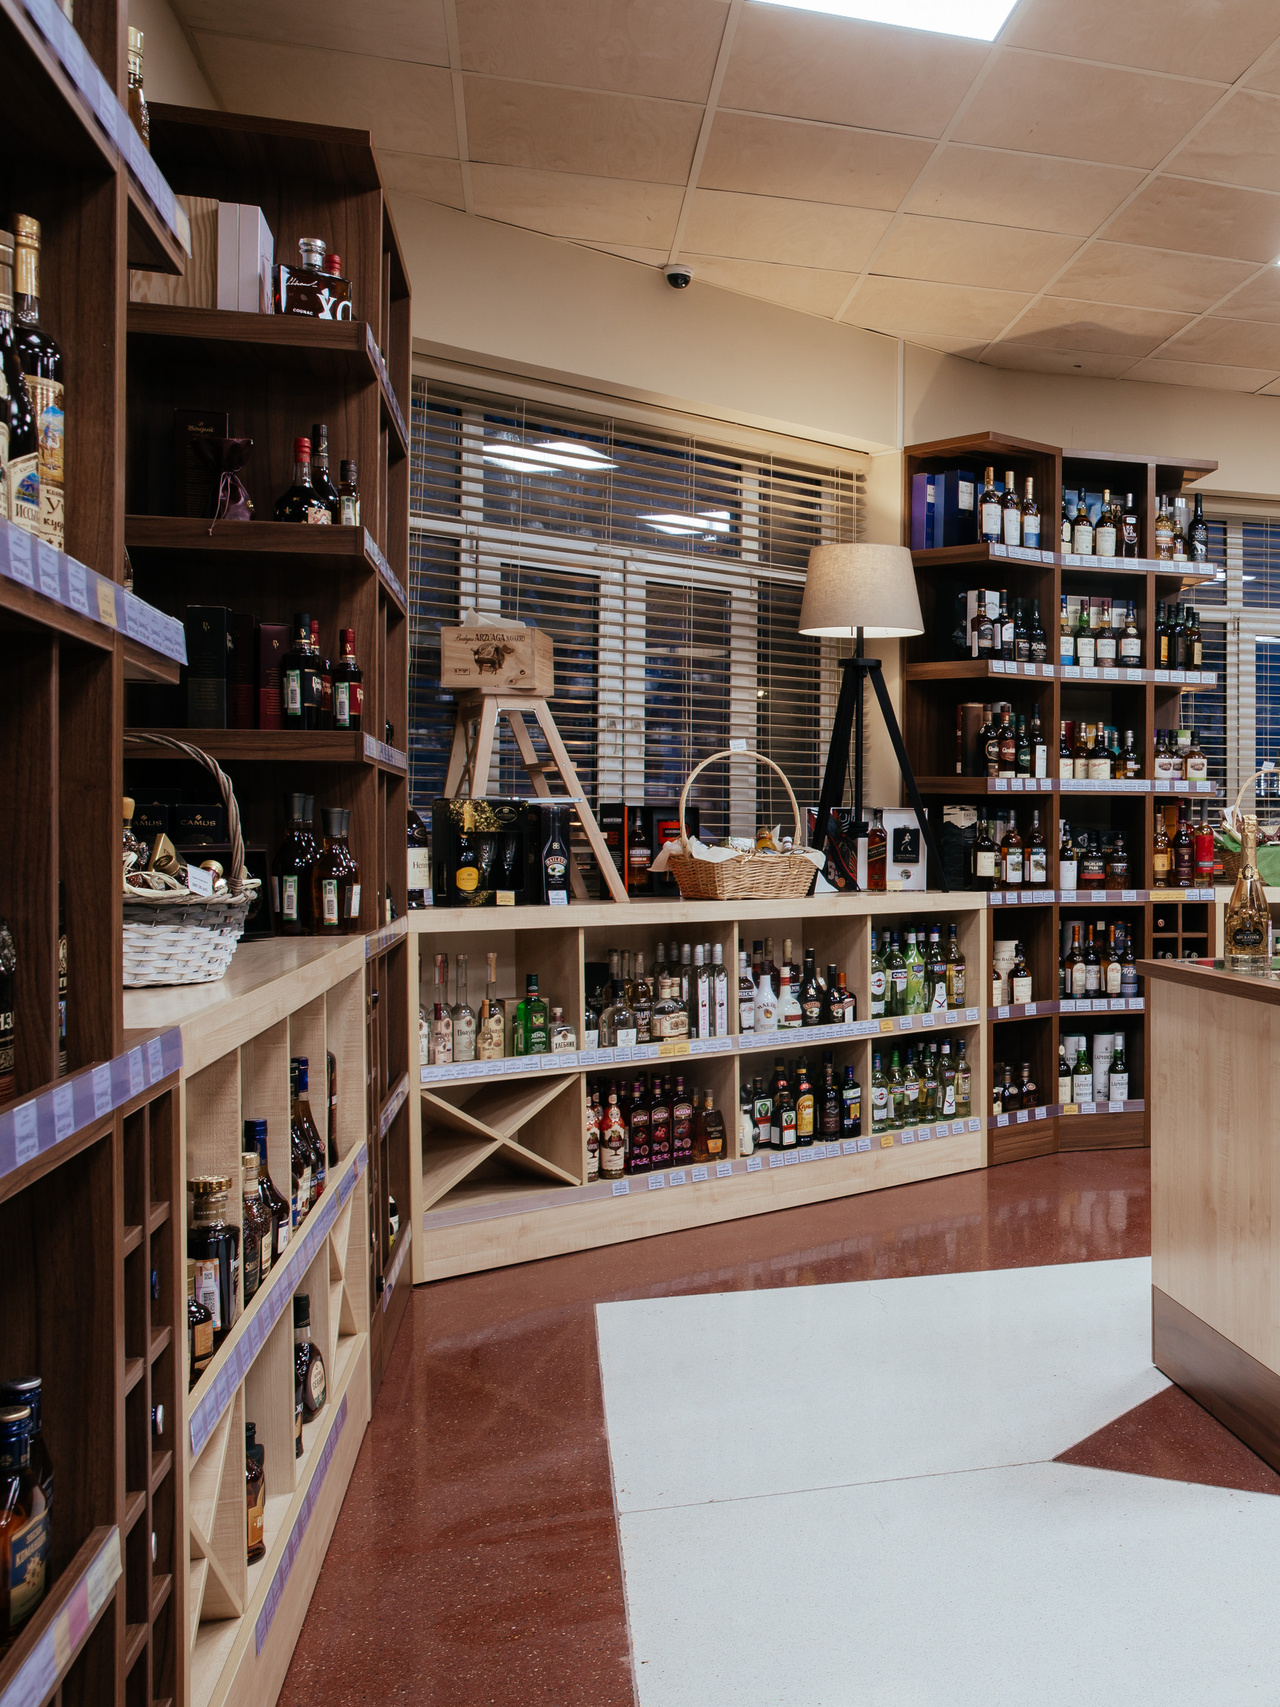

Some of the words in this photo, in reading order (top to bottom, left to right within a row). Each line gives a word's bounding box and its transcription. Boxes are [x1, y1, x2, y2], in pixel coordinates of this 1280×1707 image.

[292, 308, 314, 316] COGNAC
[475, 633, 506, 642] ARZUAGA
[133, 819, 163, 827] AMUS
[180, 819, 217, 827] CAMUS
[554, 1041, 576, 1049] ХЛЕБНИК
